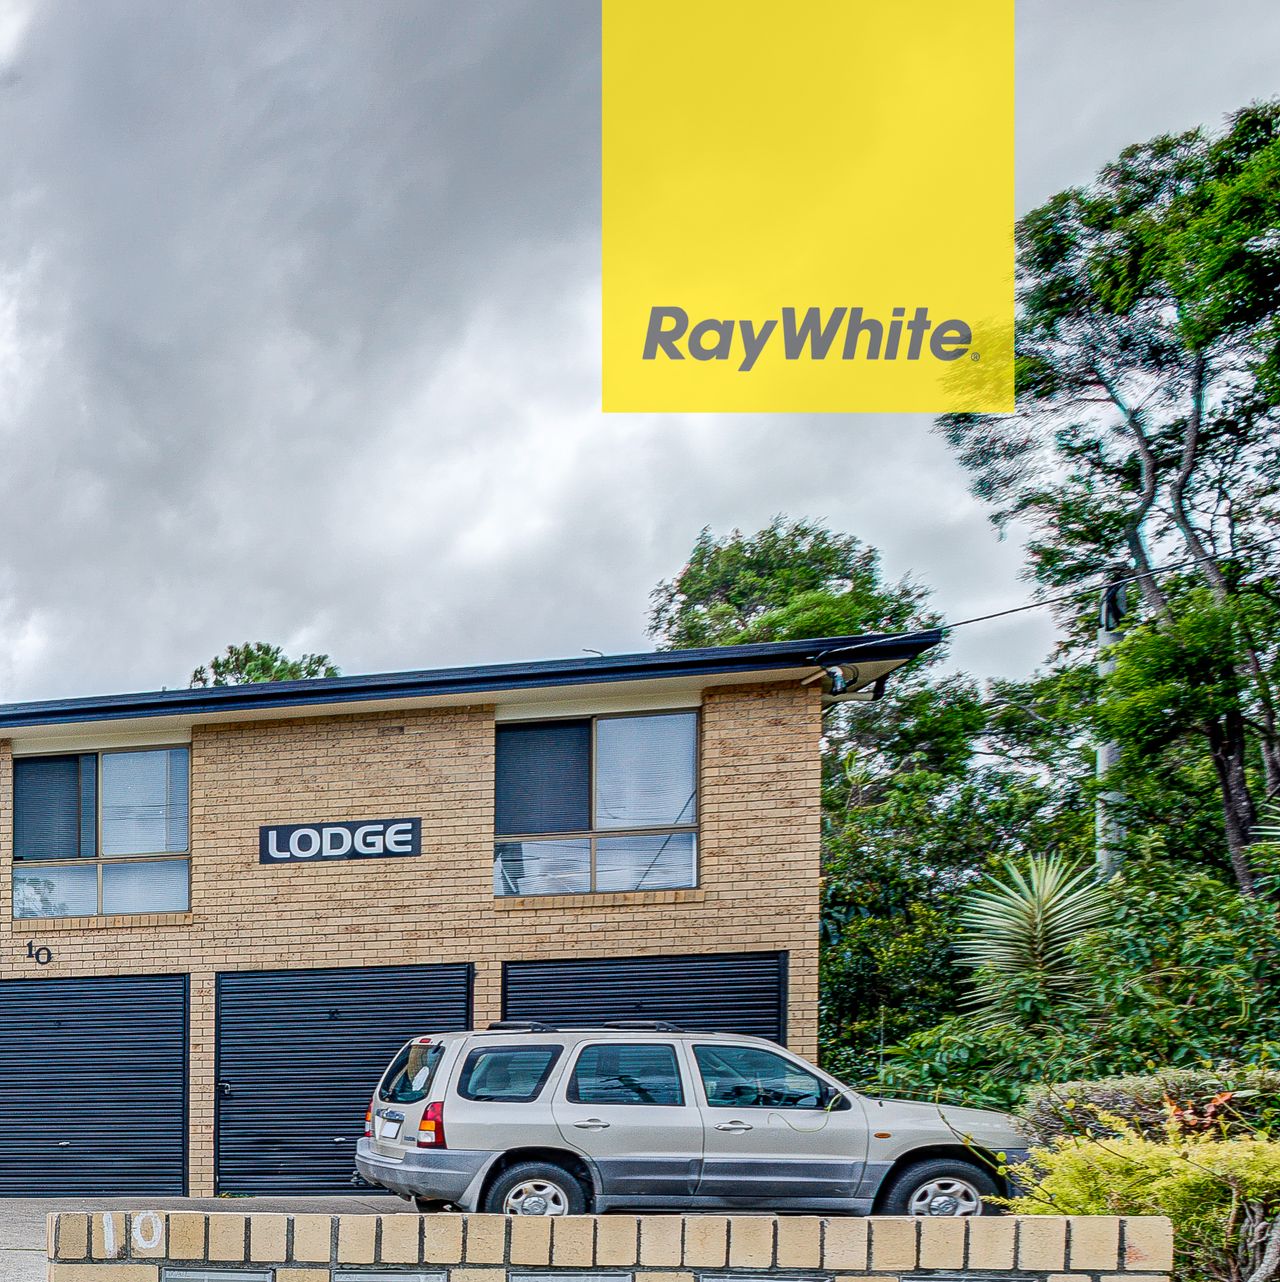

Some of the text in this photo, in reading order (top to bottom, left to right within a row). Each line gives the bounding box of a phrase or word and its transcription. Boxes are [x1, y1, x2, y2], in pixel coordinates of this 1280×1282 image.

[268, 823, 412, 858] LODGE
[26, 940, 52, 965] 10
[103, 1210, 162, 1258] 10
